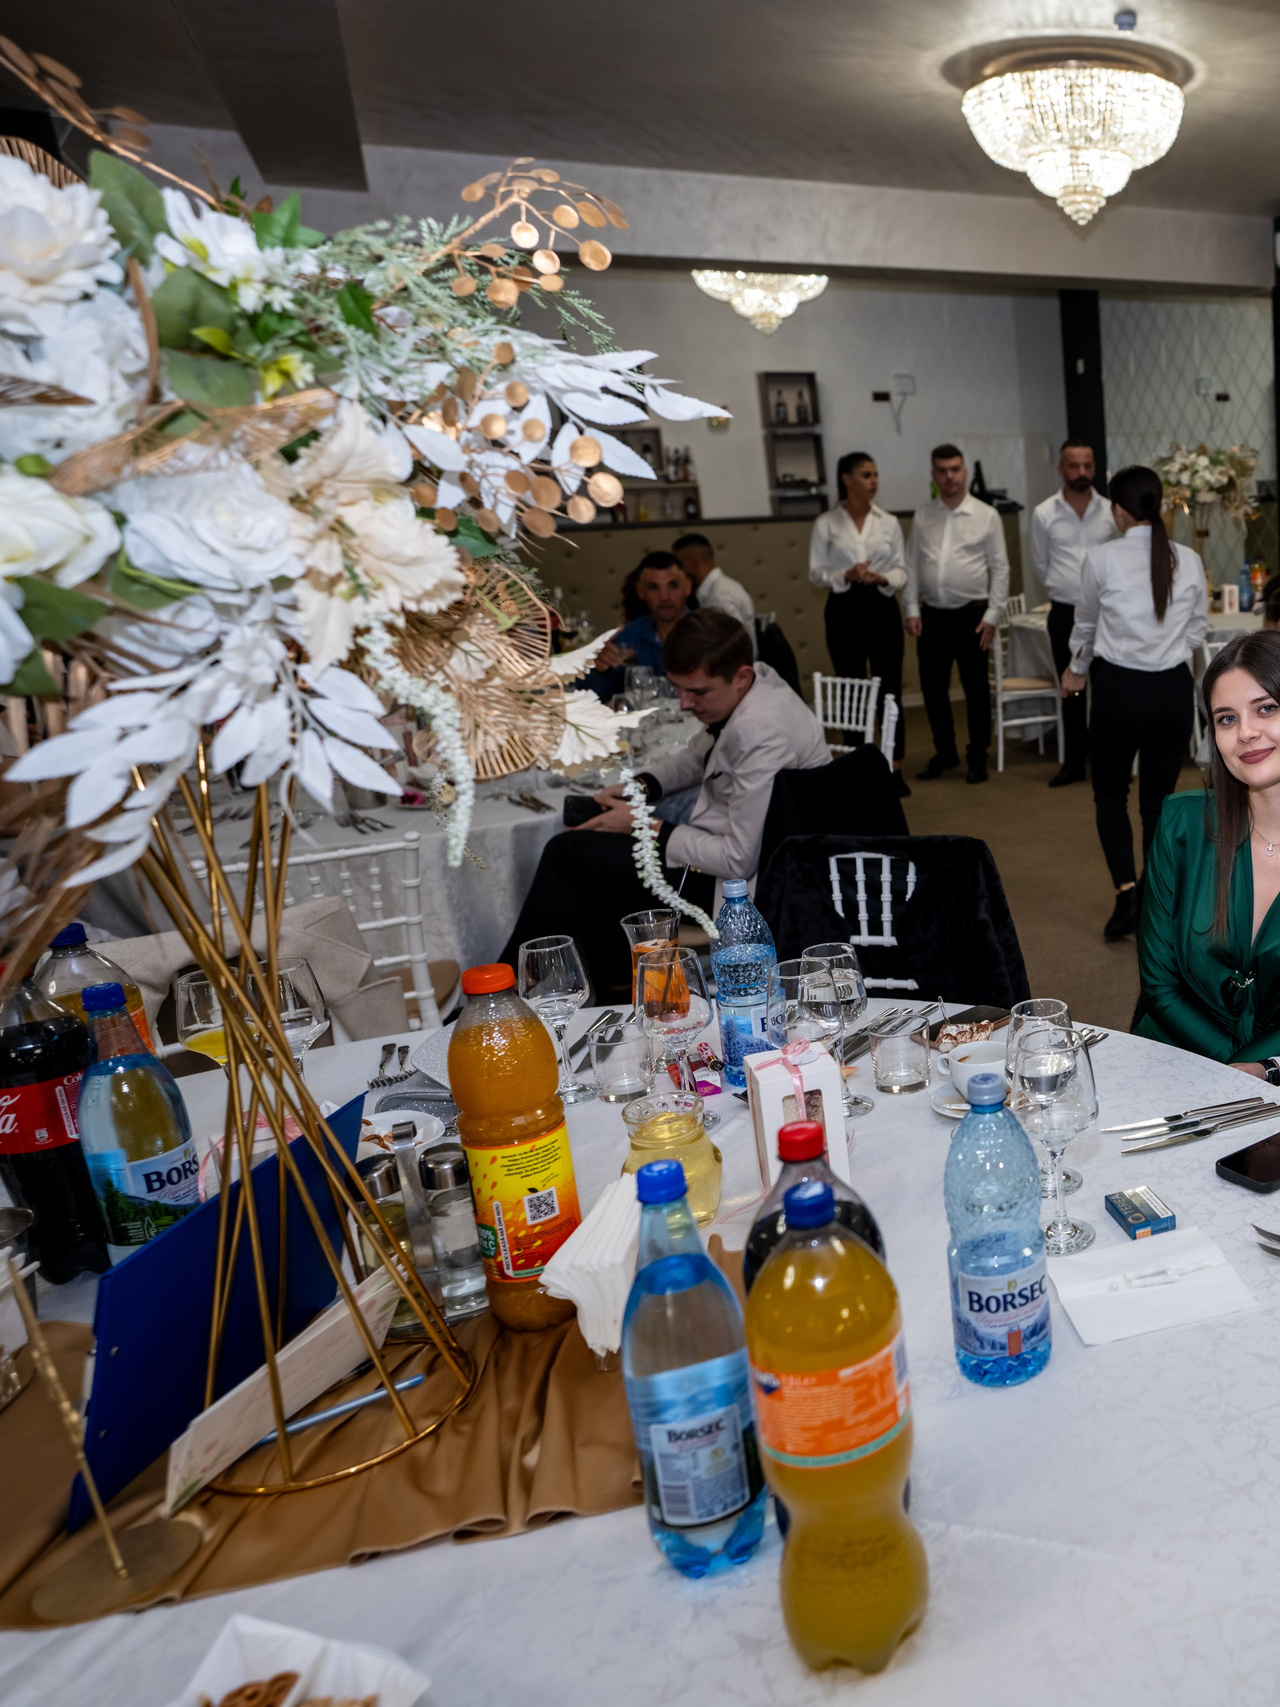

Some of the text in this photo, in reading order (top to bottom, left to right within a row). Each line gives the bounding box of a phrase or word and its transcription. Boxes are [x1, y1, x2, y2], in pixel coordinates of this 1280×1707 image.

[63, 1073, 84, 1086] Cok
[142, 1154, 200, 1194] BORS
[1111, 1193, 1134, 1215] TEREA
[967, 1274, 1047, 1314] BORSEC
